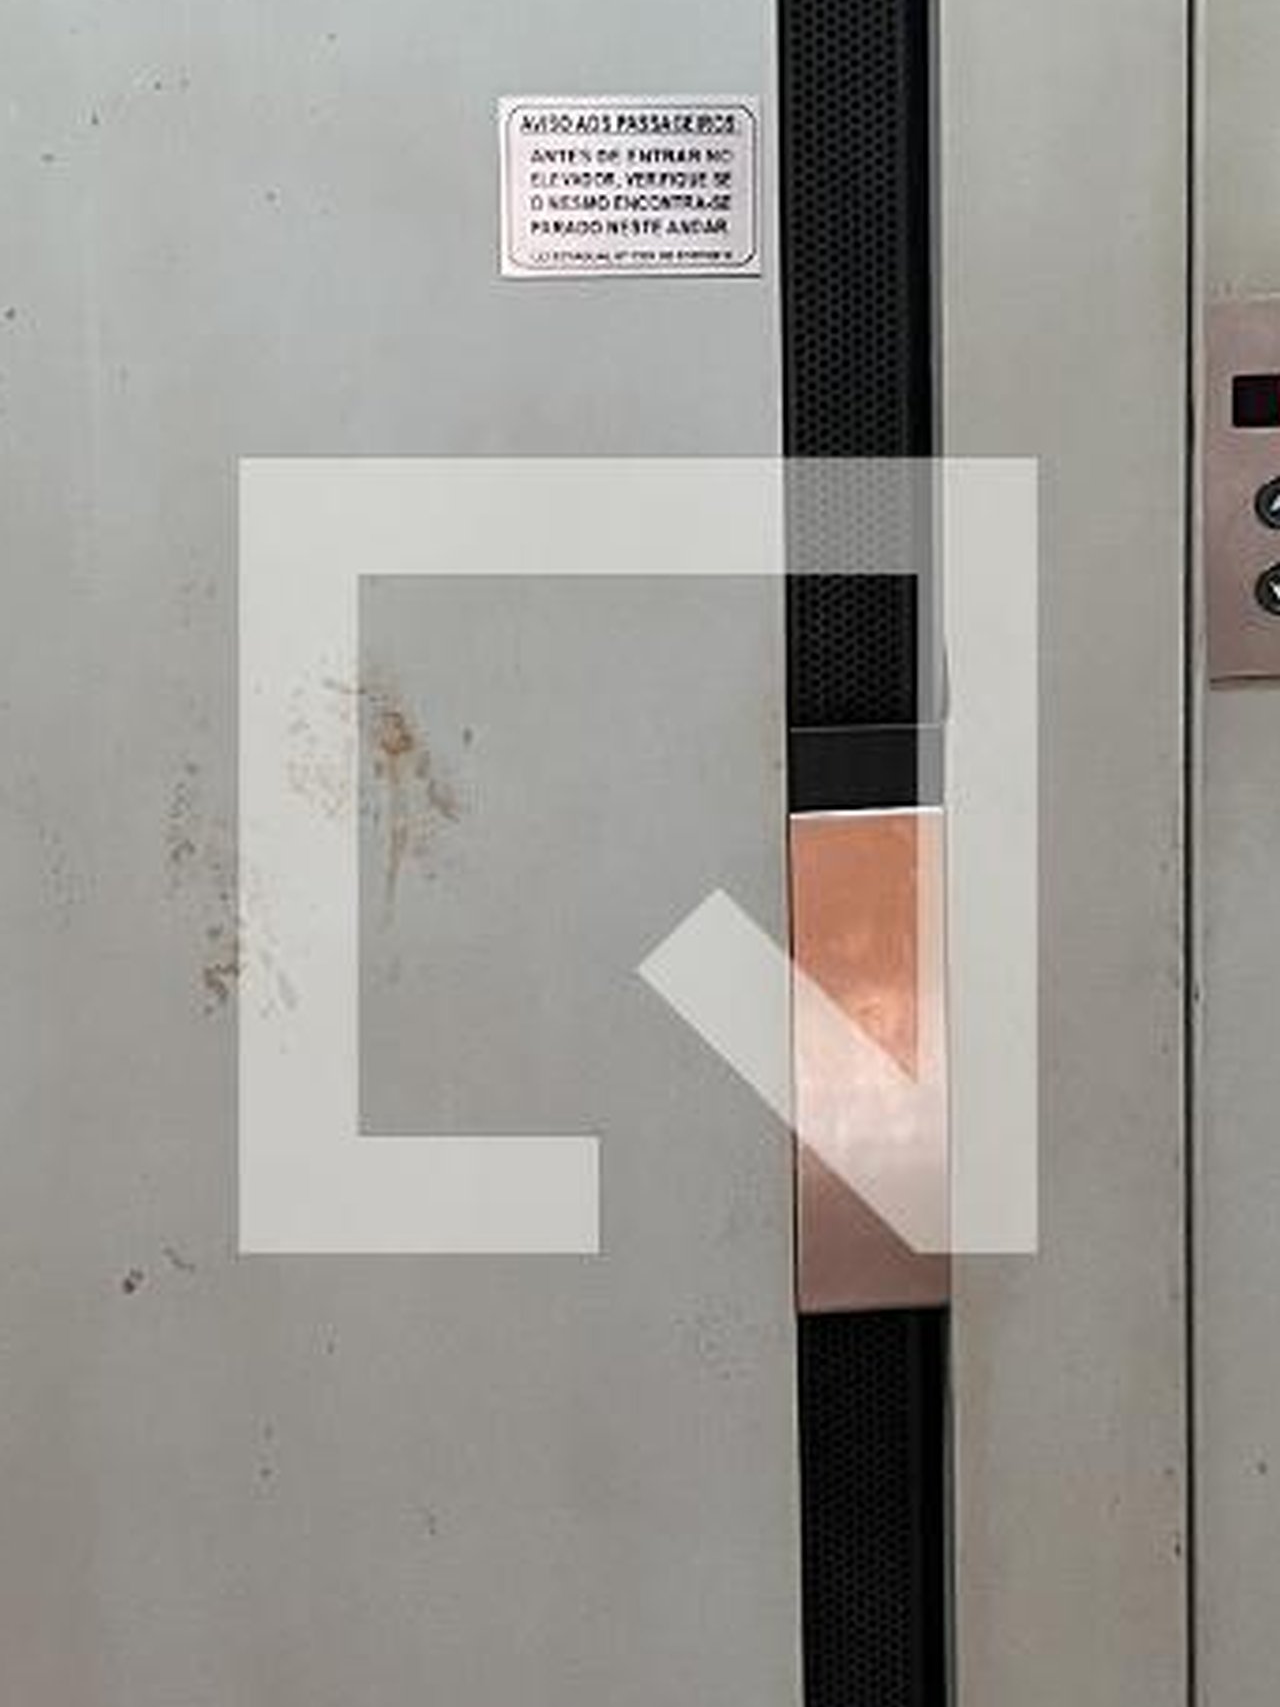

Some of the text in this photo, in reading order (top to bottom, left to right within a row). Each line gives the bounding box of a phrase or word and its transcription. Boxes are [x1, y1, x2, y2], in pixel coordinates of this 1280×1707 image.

[520, 114, 572, 134] AVISO
[575, 114, 612, 134] AOS
[531, 149, 592, 163] ANTES
[627, 149, 701, 163] ENTRAR
[706, 149, 733, 163] NO
[626, 172, 707, 188] VERIFIQUE
[713, 172, 731, 188] SE
[530, 195, 543, 210] O
[531, 220, 603, 236] PARADO
[606, 220, 662, 235] NESTE
